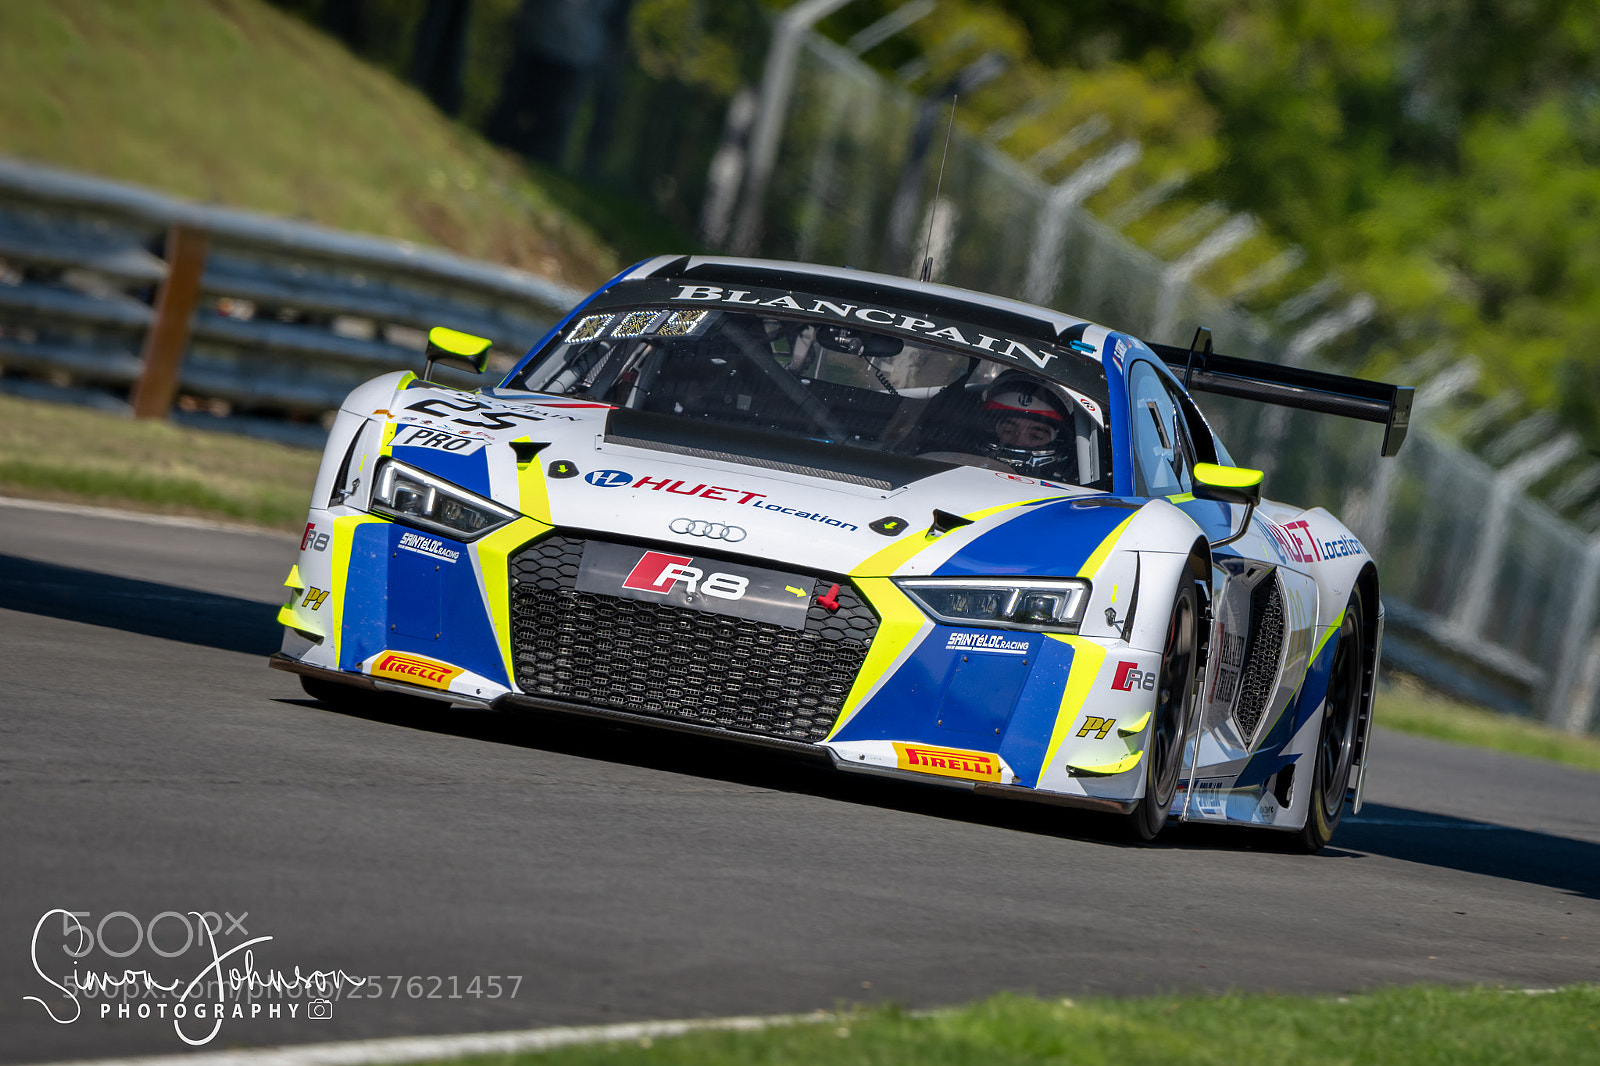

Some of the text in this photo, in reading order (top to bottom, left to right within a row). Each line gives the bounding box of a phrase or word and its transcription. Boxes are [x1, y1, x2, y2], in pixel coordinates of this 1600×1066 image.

[671, 285, 1058, 369] BLANCPAIN
[404, 399, 545, 430] 25
[403, 429, 472, 451] PRO
[631, 476, 859, 532] HUET Location
[306, 531, 330, 552] R8
[652, 562, 750, 601] R8
[379, 655, 453, 683] PIRELLI
[1124, 668, 1156, 691] R8
[905, 748, 992, 775] PIRELLI
